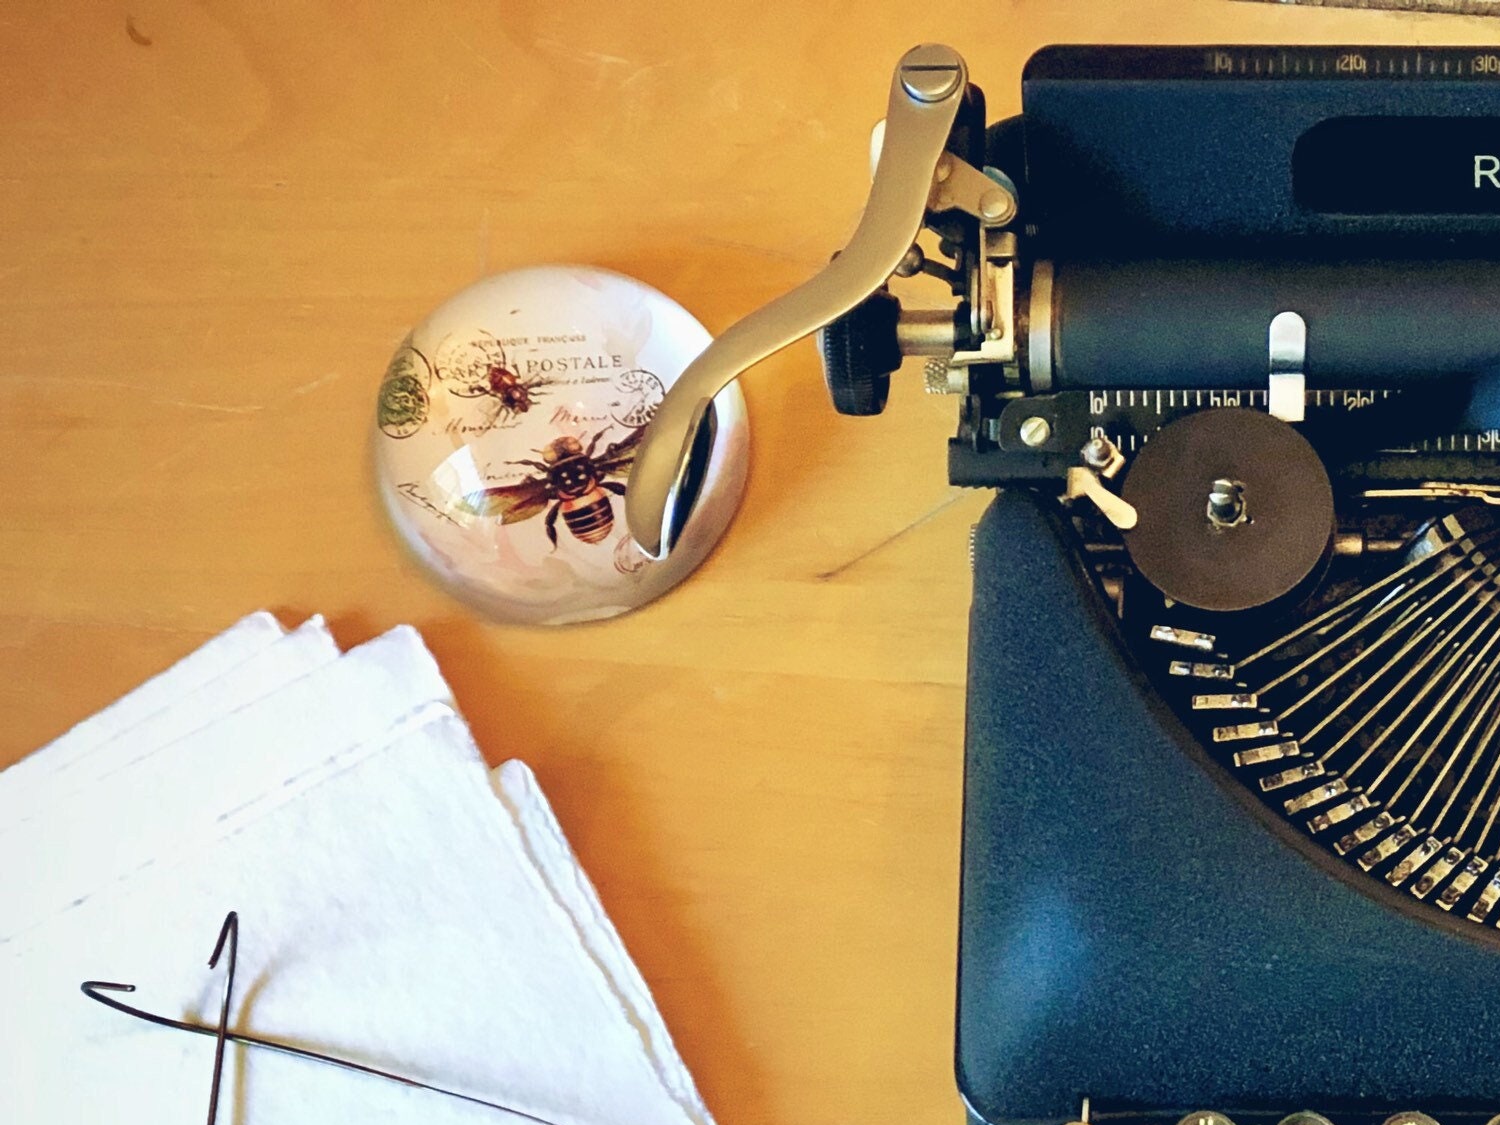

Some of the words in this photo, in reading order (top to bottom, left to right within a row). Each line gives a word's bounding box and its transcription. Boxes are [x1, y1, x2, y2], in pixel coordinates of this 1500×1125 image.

[1340, 54, 1362, 71] 20
[1475, 55, 1498, 72] 30
[526, 354, 623, 373] POSTALE
